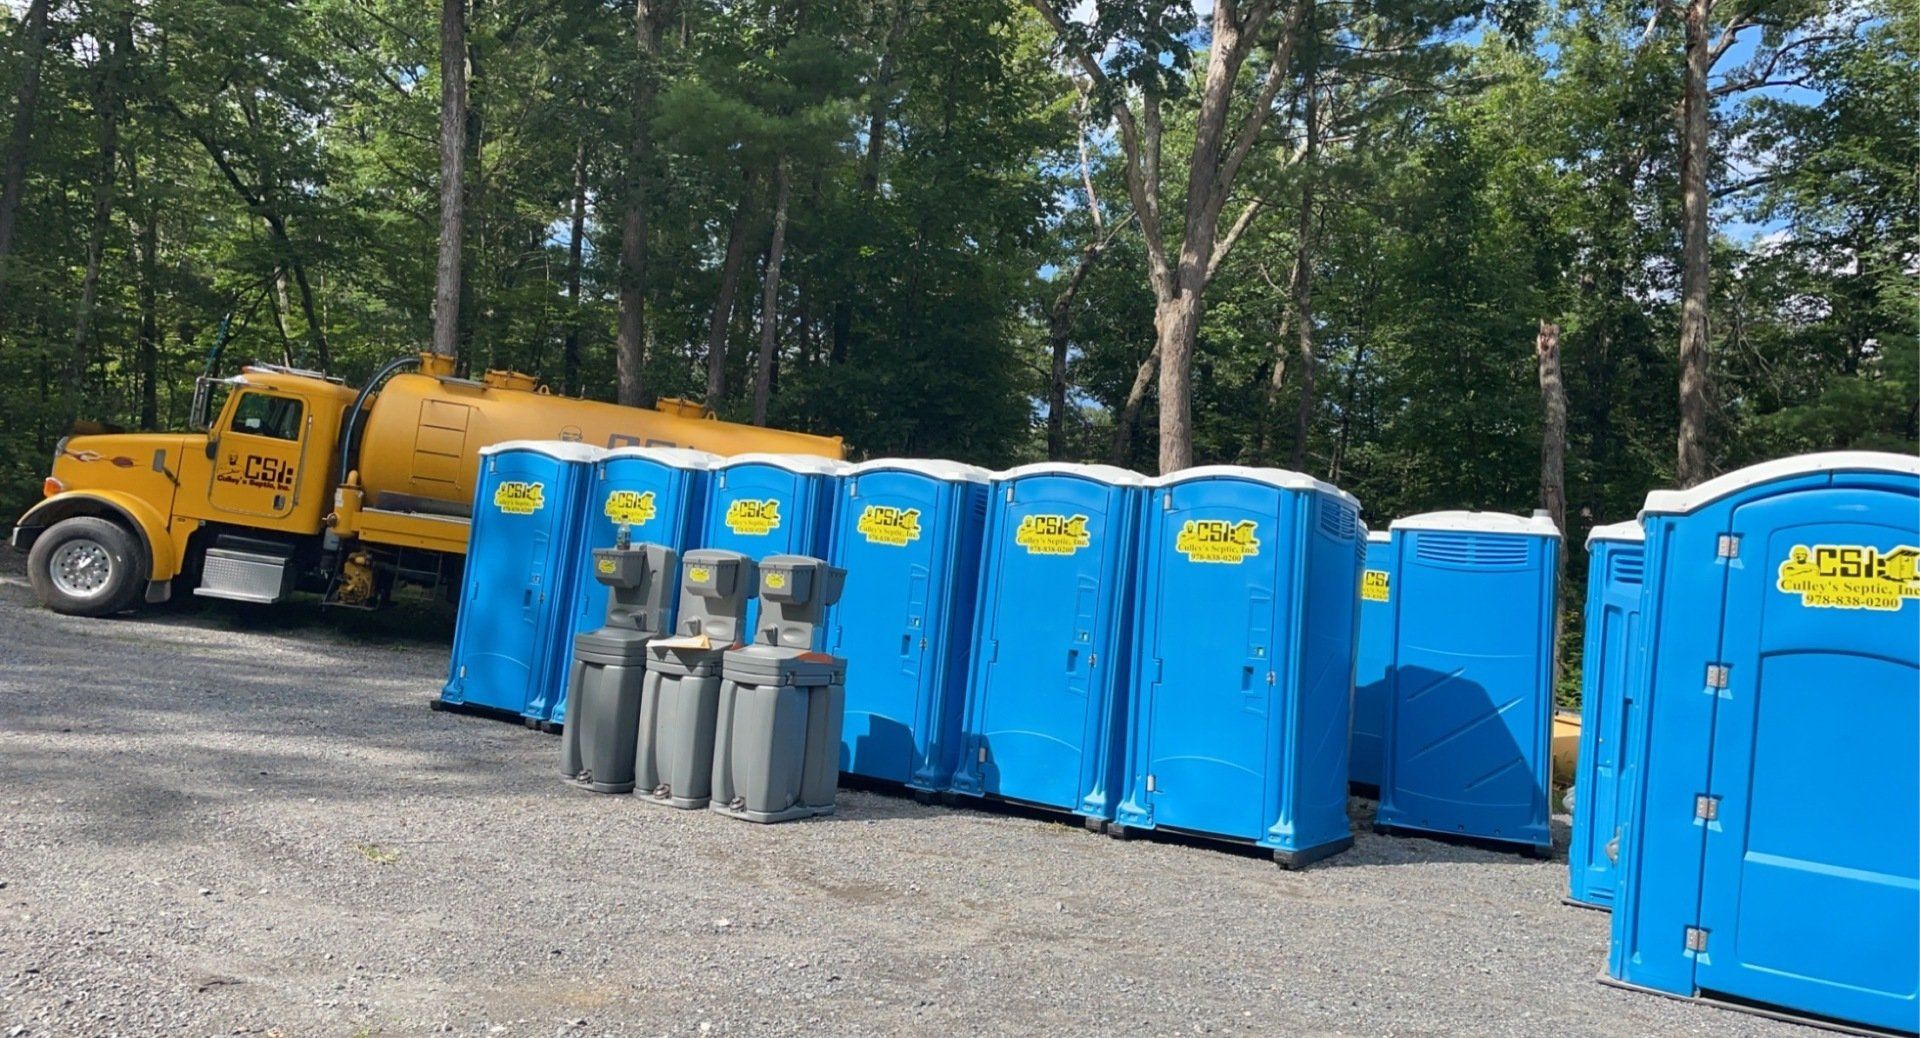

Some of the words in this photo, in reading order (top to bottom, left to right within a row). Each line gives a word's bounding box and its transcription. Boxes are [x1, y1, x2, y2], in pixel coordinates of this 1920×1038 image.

[1241, 546, 1258, 554] Inc.
[1781, 580, 1838, 593] Culley's
[1806, 594, 1899, 608] 978-838-0200
